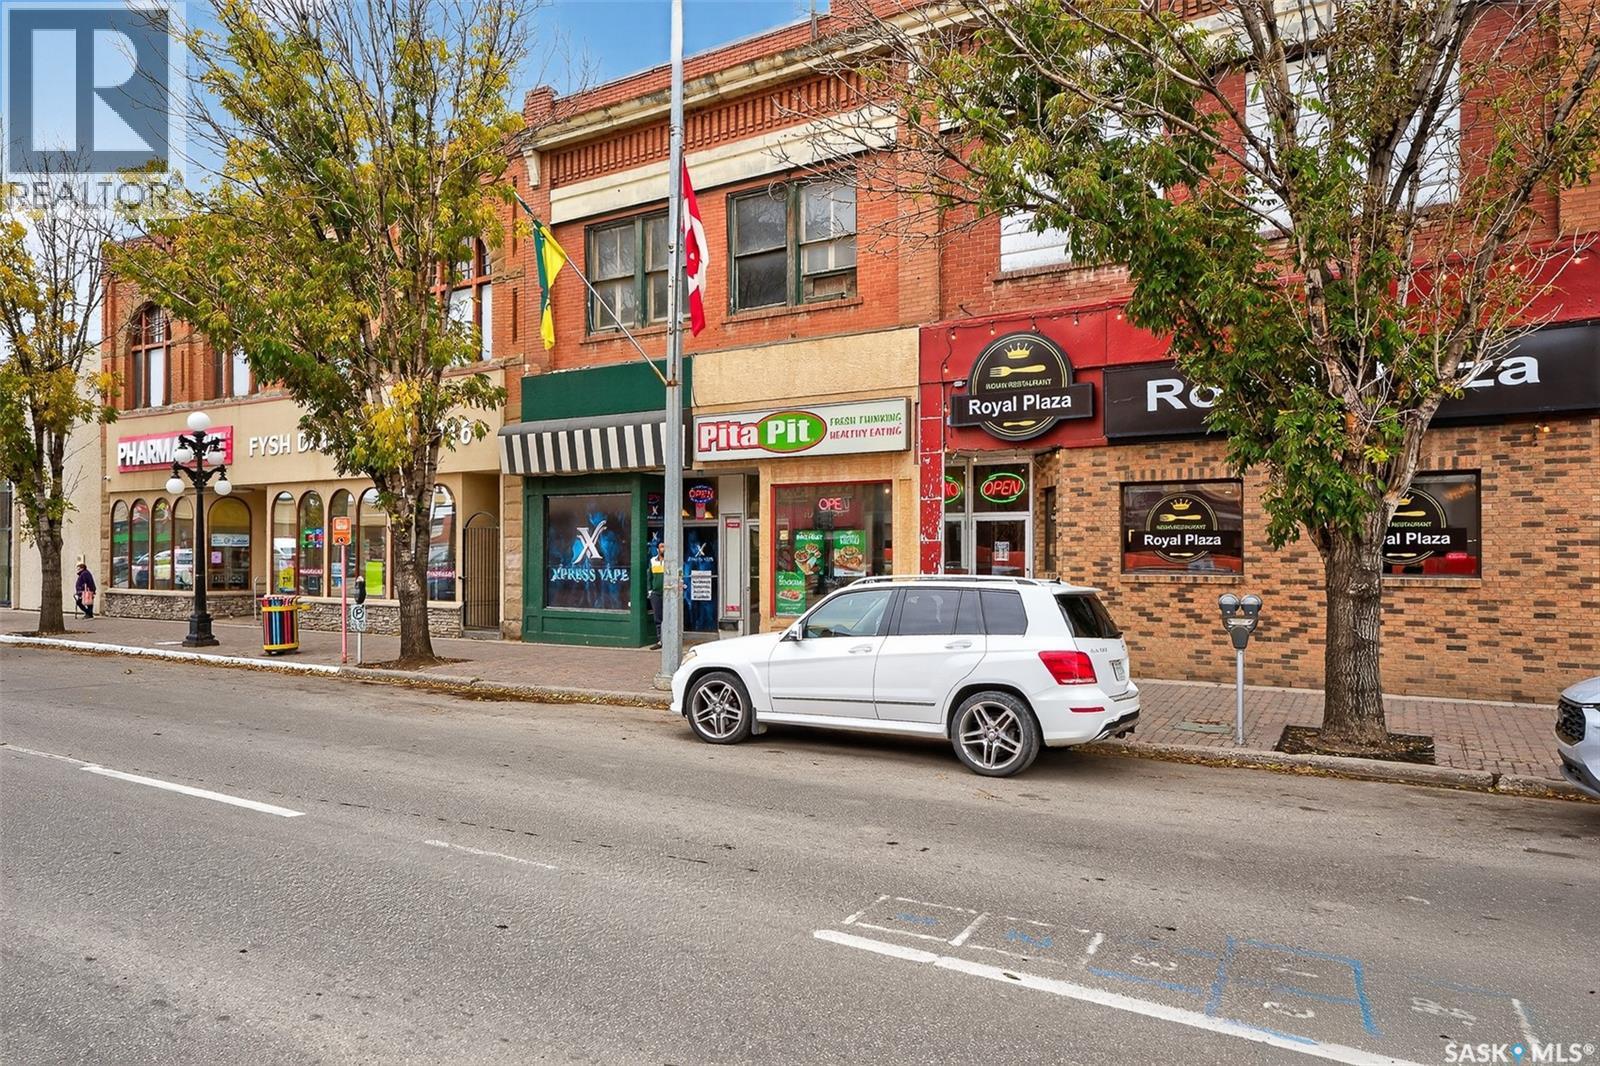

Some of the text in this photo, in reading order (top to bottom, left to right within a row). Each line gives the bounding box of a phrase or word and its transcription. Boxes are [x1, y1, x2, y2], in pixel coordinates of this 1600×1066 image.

[1008, 378, 1052, 389] RESTAURANT
[968, 394, 1072, 417] Royal Plaza
[830, 416, 856, 426] FRESH
[698, 419, 811, 452] Pita Pit
[830, 426, 902, 439] HEALTHY EATING
[248, 433, 291, 456] FYSH
[689, 488, 714, 500] OPEN
[983, 480, 1021, 496] OPEN
[1144, 534, 1221, 548] Royal Plaza
[1405, 532, 1451, 545] Plaza
[550, 563, 629, 583] XPRESS VAPE
